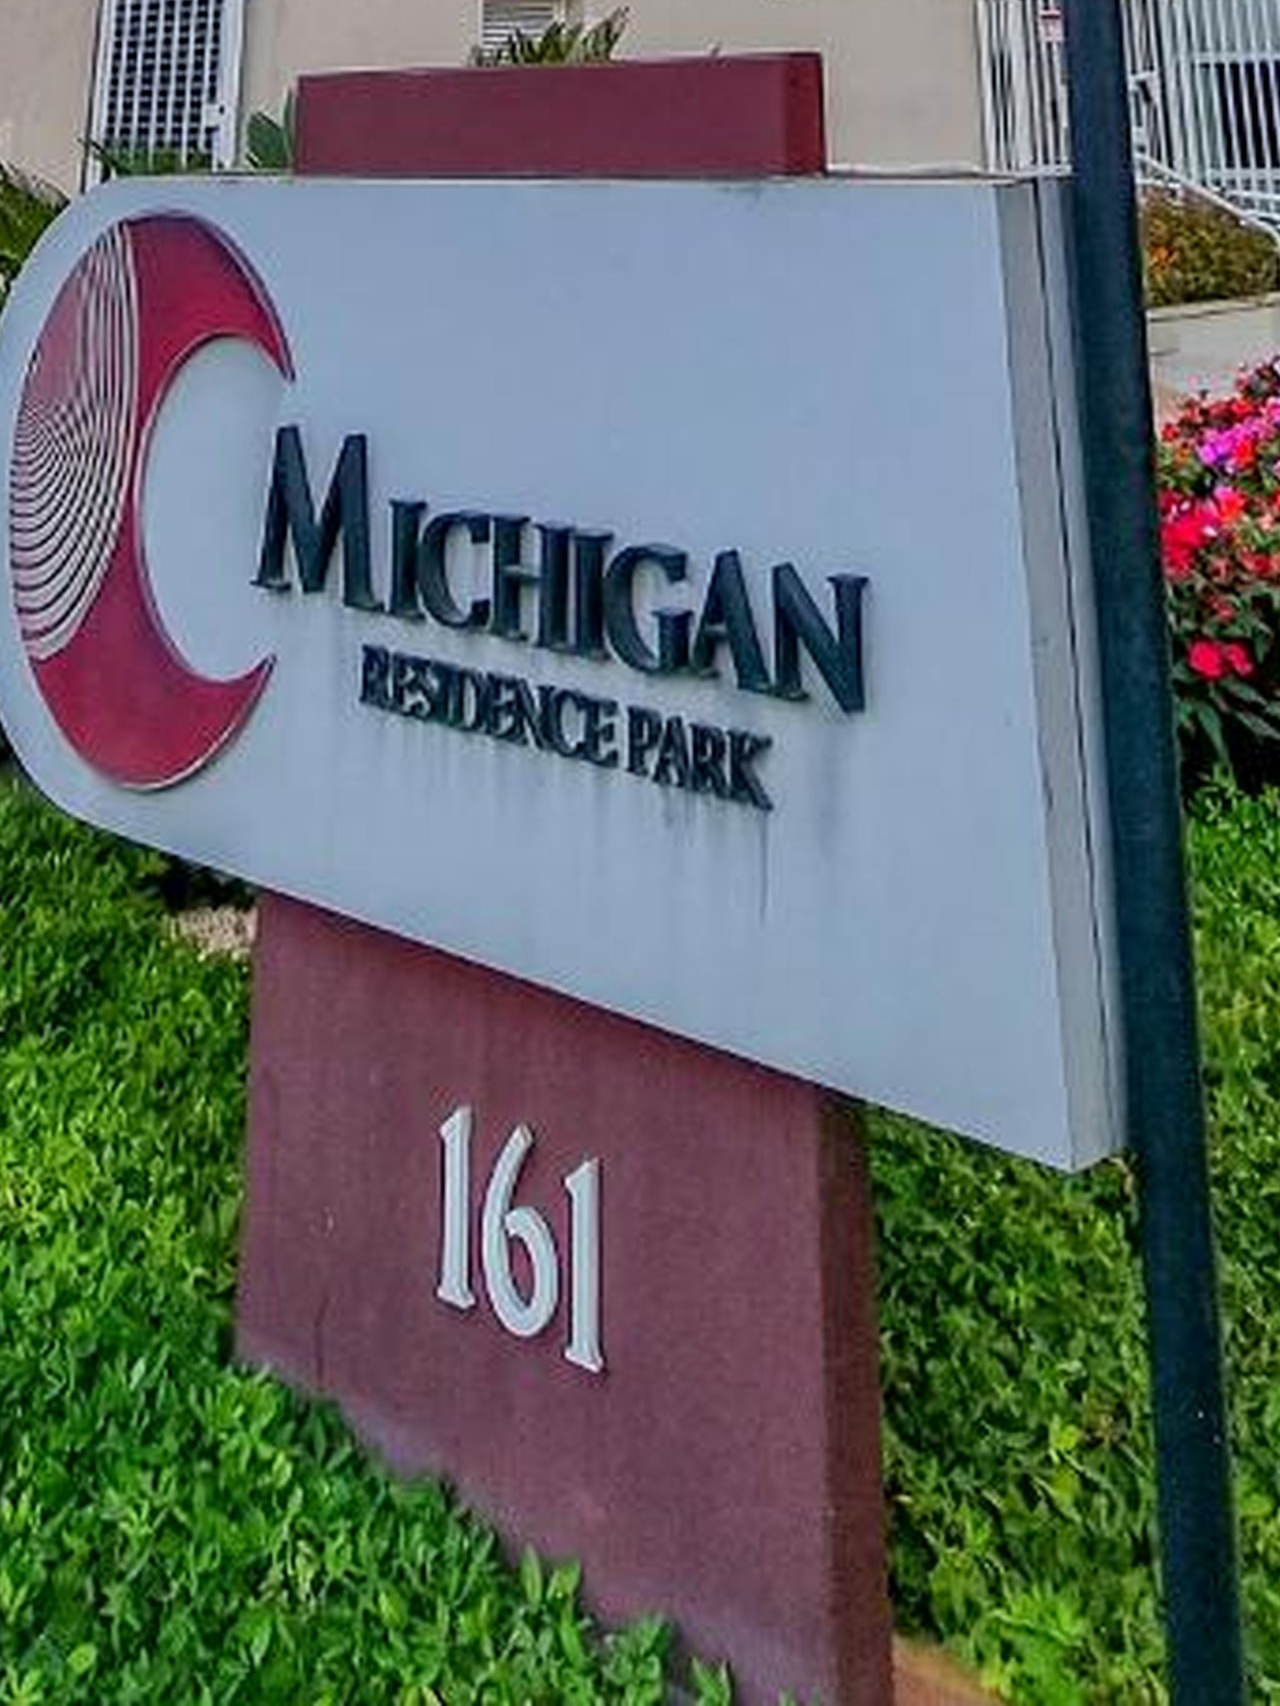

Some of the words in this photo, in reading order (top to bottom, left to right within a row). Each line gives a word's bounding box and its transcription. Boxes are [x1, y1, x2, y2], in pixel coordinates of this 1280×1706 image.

[360, 644, 619, 769] RESIDENCE
[626, 704, 776, 812] PARK
[436, 1105, 605, 1374] 161
